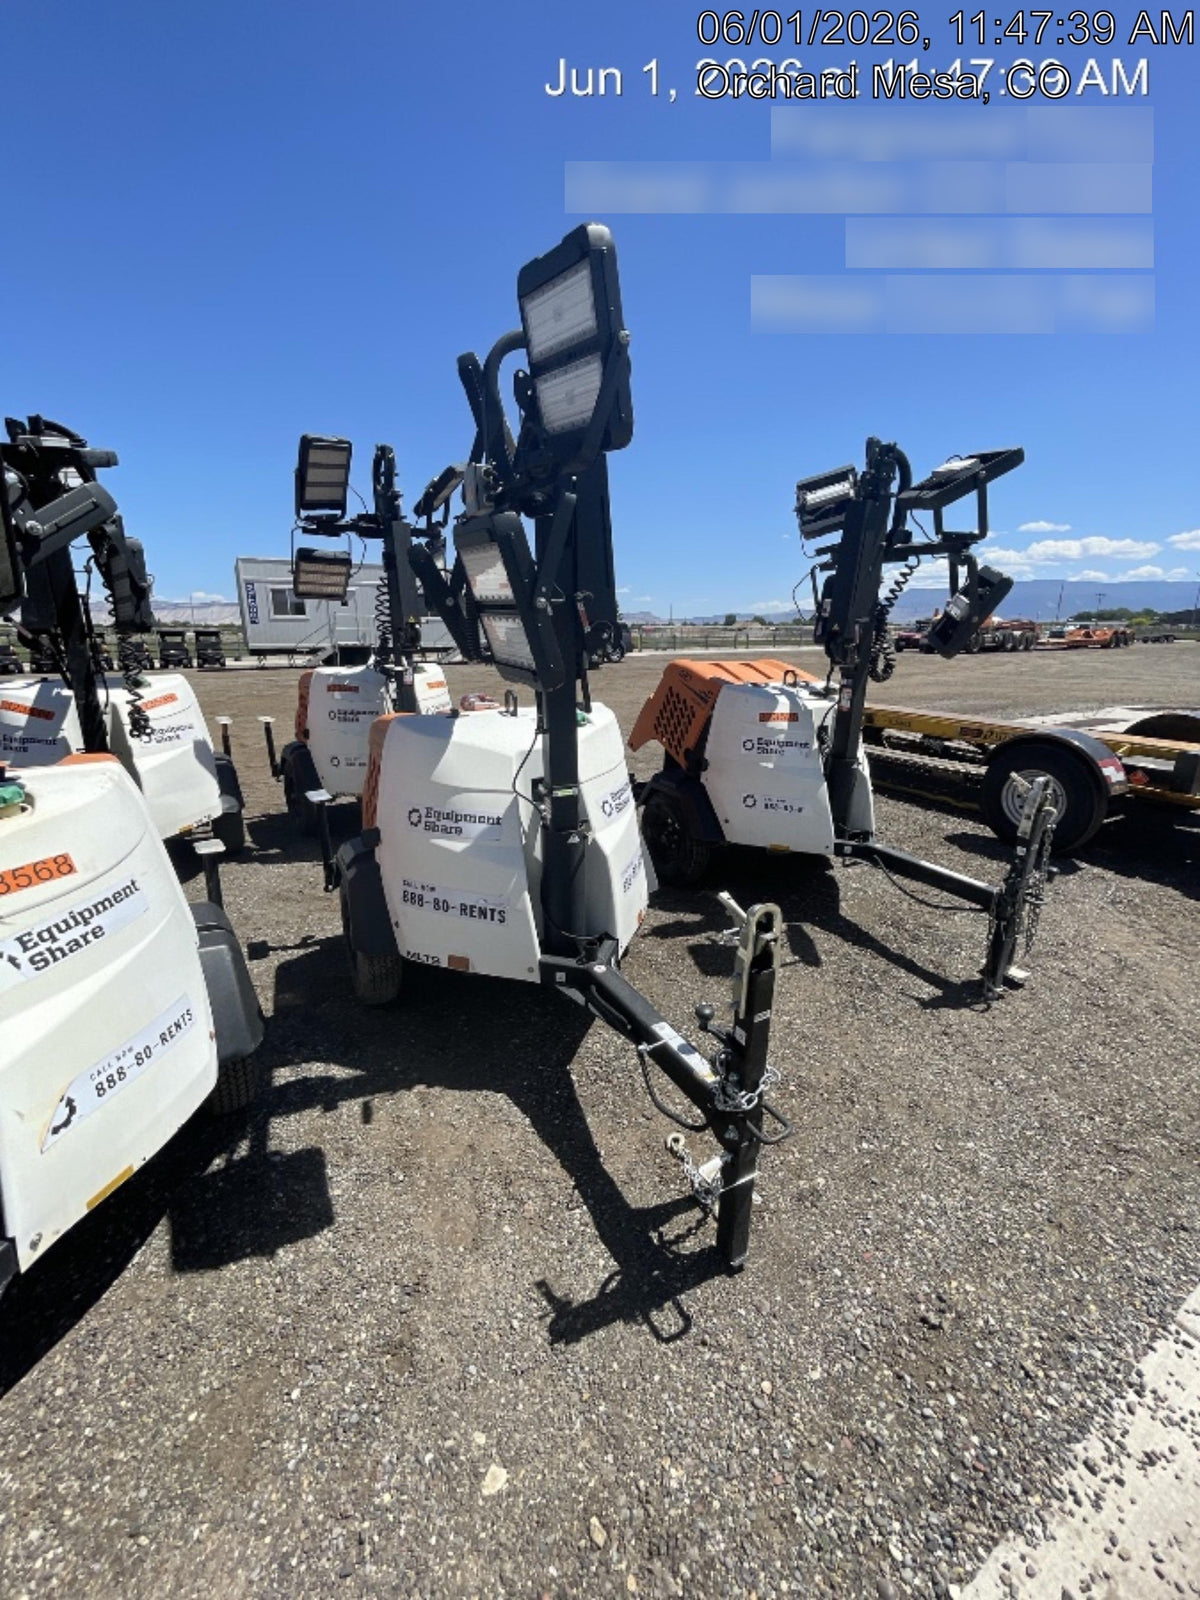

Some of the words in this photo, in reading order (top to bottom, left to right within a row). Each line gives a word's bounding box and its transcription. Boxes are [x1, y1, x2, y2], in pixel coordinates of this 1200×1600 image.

[424, 806, 502, 826] Equipment
[424, 820, 463, 836] Share
[14, 878, 140, 953] Equipment
[402, 889, 506, 924] 888-80-RENTS
[28, 924, 106, 972] Share
[95, 1008, 193, 1098] 888-80-RENTS
